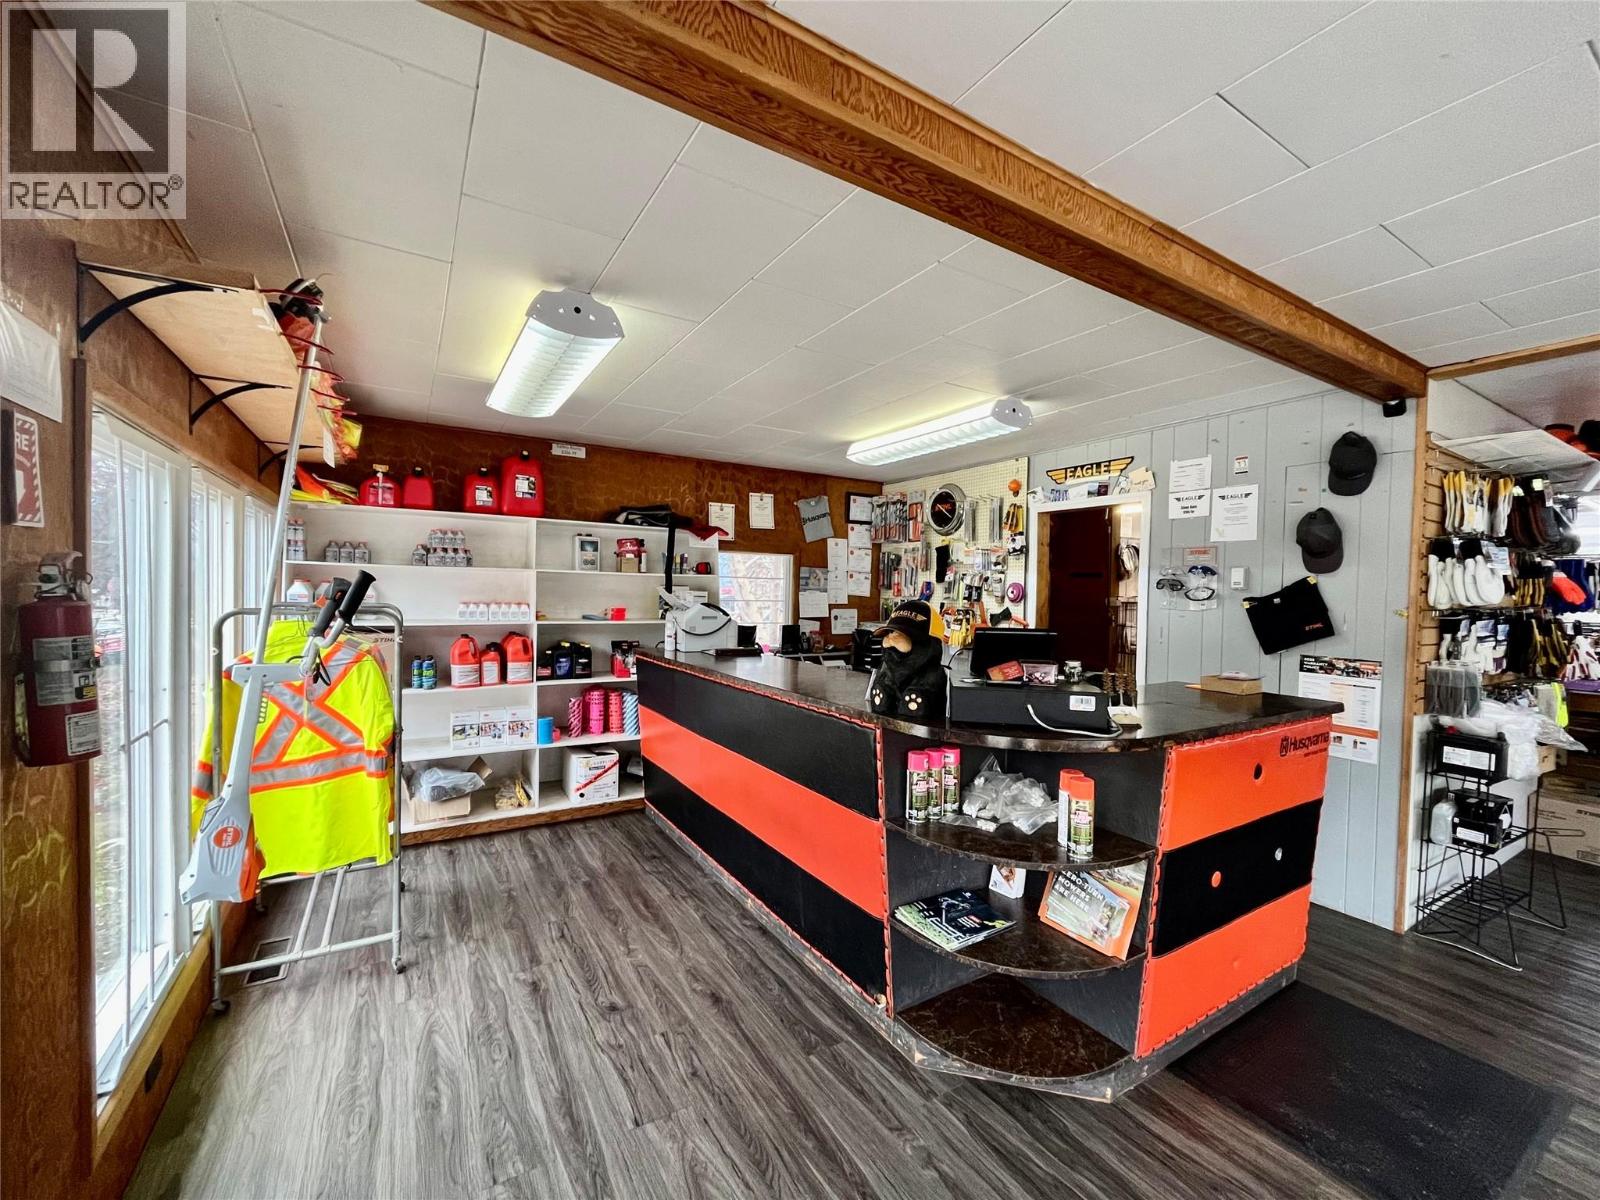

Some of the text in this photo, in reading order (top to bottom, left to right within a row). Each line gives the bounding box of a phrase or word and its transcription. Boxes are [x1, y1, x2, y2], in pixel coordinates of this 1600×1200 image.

[1066, 462, 1109, 480] EAGLE
[1289, 731, 1330, 753] Husqvarna
[1058, 876, 1090, 902] MOWERS
